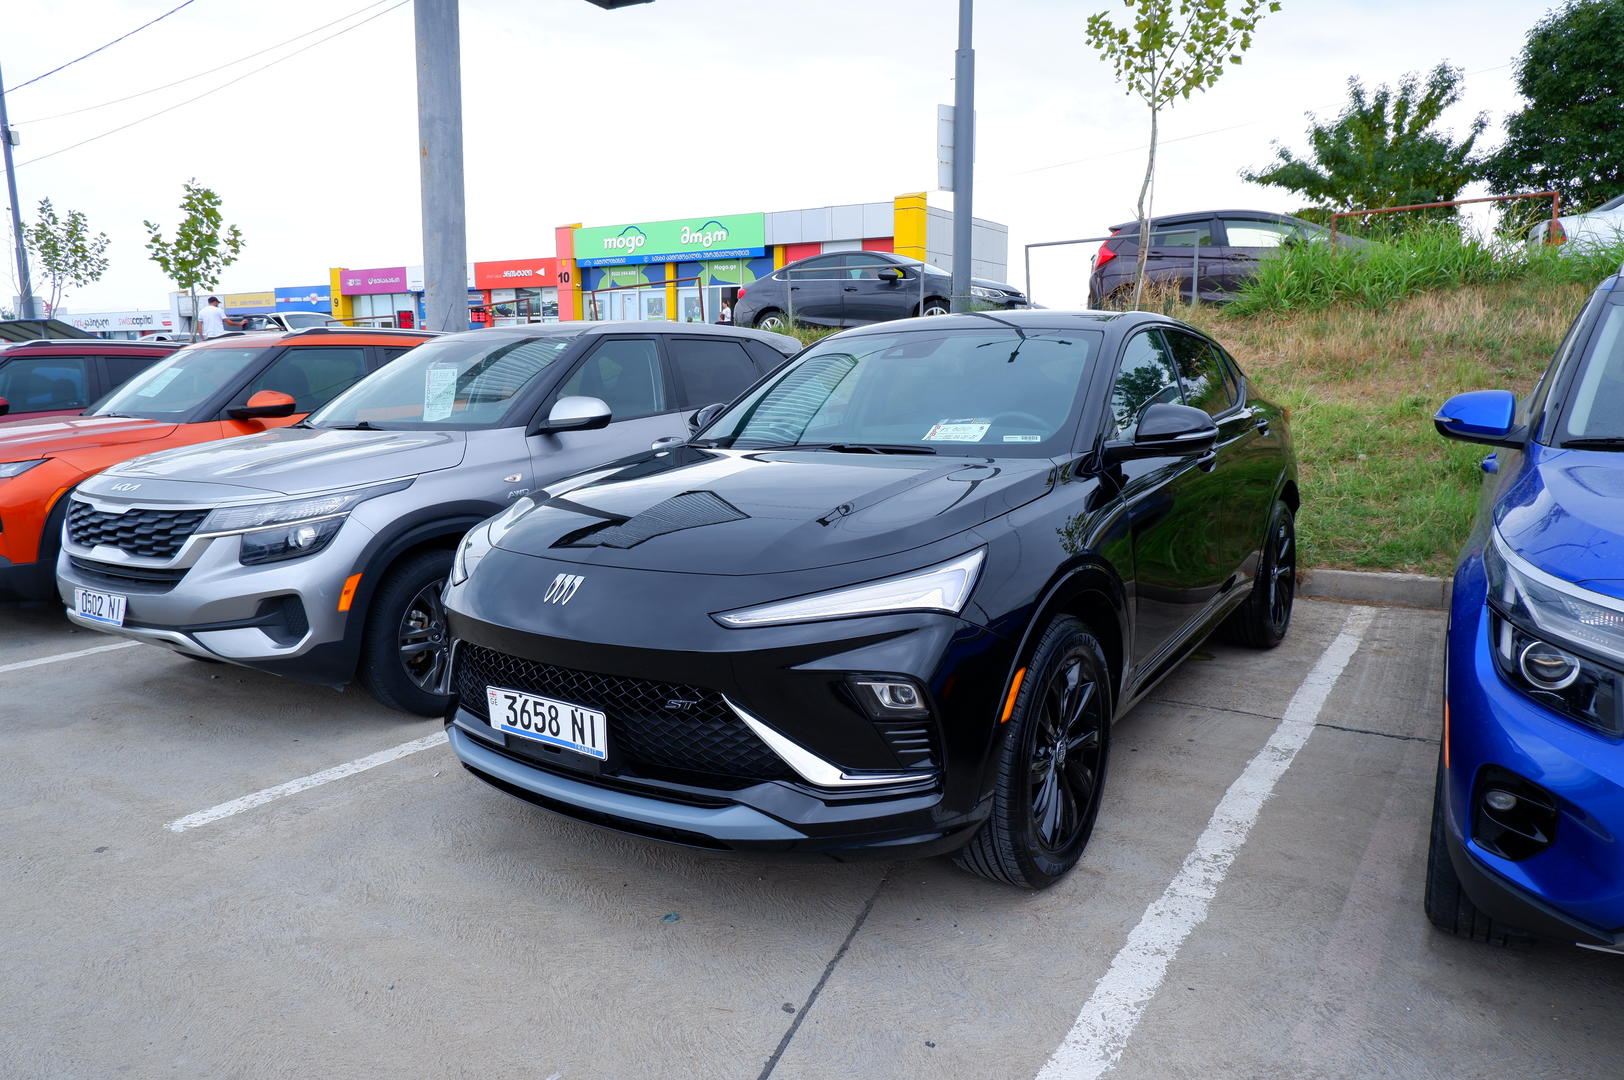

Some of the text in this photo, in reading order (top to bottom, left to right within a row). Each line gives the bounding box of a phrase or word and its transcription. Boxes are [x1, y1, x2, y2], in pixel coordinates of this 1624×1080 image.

[603, 235, 645, 254] mogo
[680, 226, 727, 248] მოგო
[558, 272, 570, 283] 10
[333, 297, 339, 307] 9
[81, 592, 121, 620] 0502 NI
[664, 699, 698, 710] ST
[503, 694, 597, 749] 3658 NI
